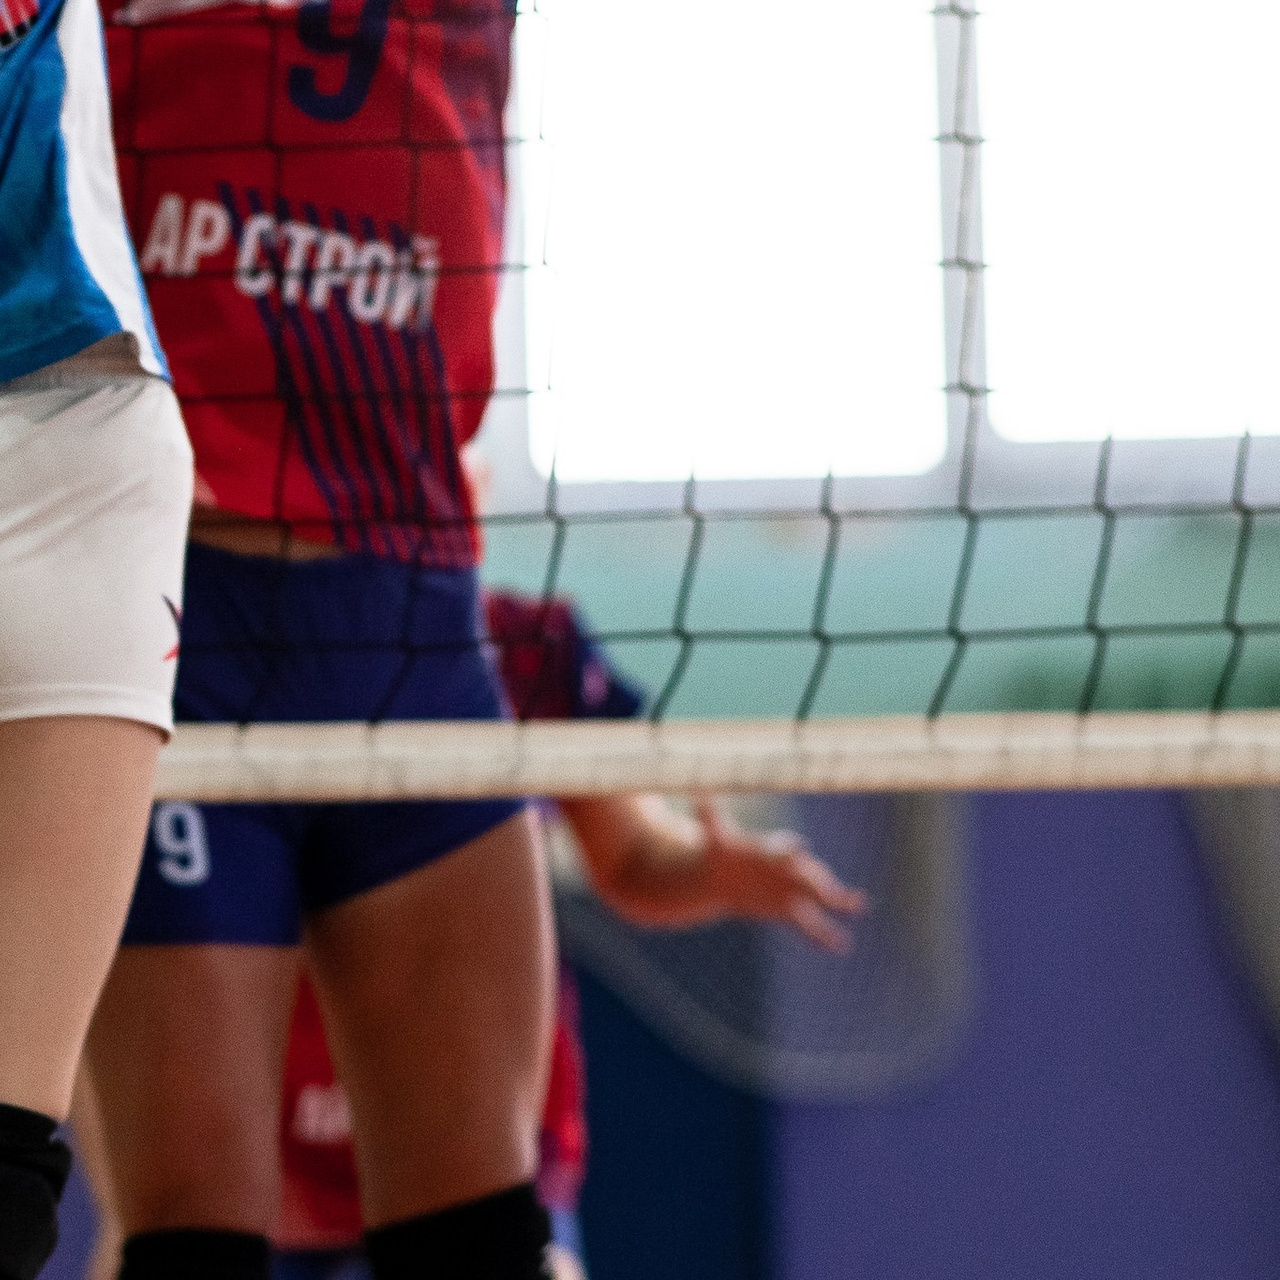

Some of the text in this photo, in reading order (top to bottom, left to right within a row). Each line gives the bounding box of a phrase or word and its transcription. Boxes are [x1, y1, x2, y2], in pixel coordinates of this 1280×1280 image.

[139, 192, 441, 332] АР СТРОЙ
[152, 801, 212, 887] 9
